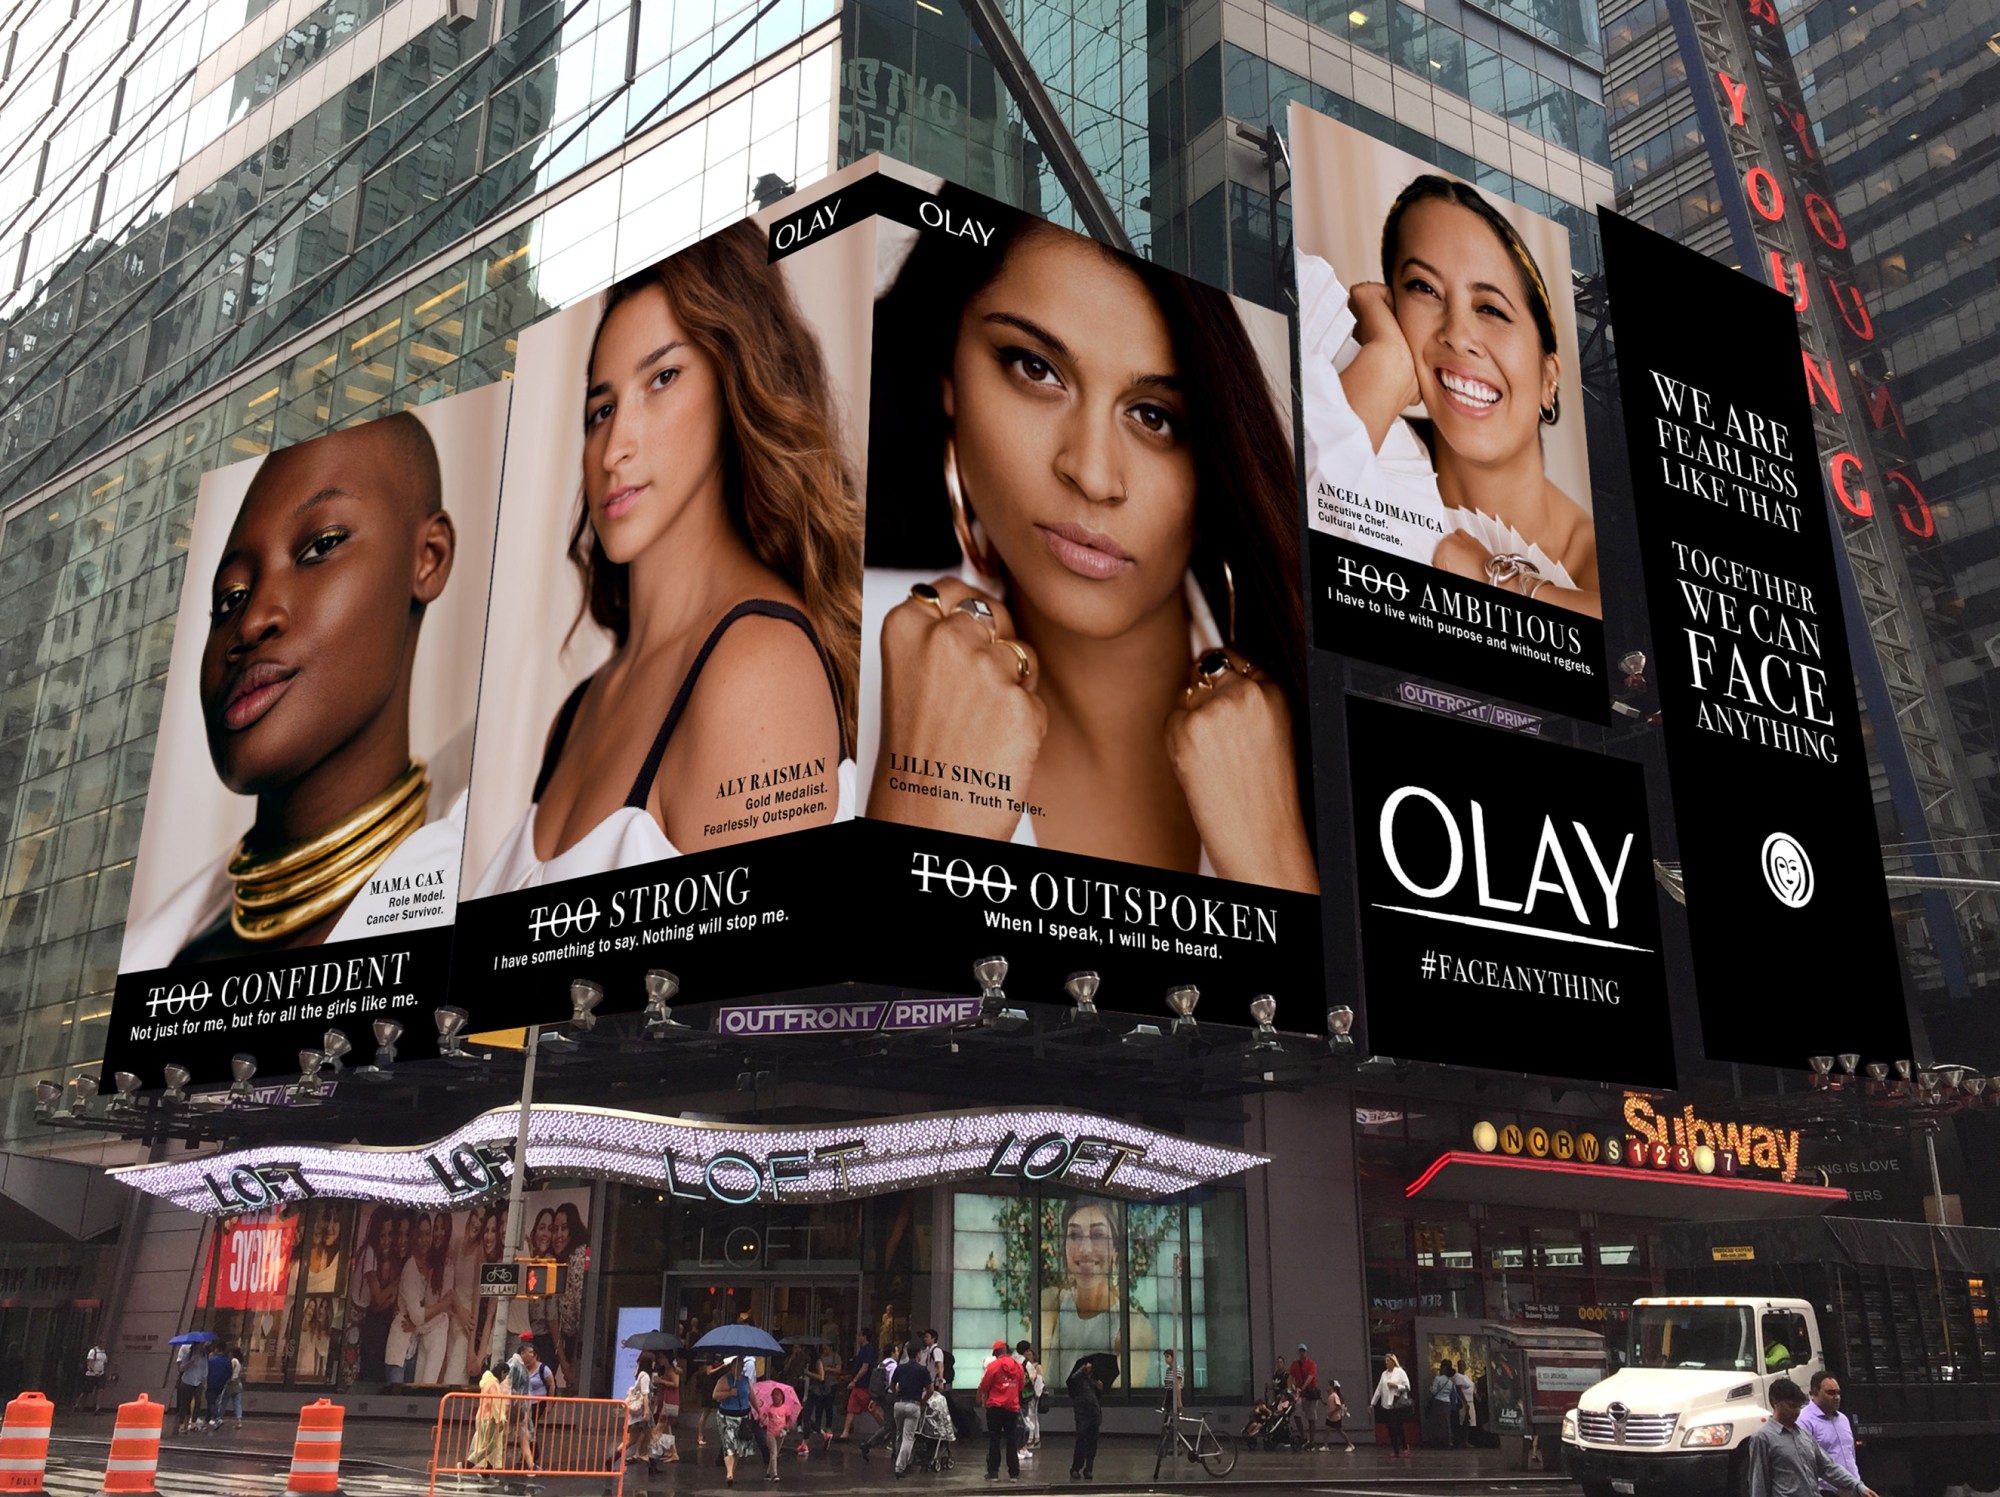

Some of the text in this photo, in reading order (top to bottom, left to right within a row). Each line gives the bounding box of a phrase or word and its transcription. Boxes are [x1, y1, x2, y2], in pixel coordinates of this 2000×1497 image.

[775, 199, 841, 249] OLAY
[919, 201, 995, 246] OLAY
[1719, 72, 1873, 517] YOUNG
[1649, 369, 1793, 462] WE ARE
[1656, 417, 1798, 498] FEARLESS
[1317, 482, 1444, 534] ANGELA DIMAYUGA
[1318, 498, 1388, 529] Executive Chef.
[1661, 456, 1801, 533] LIKE THAT
[1318, 511, 1402, 546] Cultural Advocate.
[1672, 541, 1817, 615] TOGETHER
[1338, 556, 1581, 654] TOO AMBITIOUS
[1677, 579, 1821, 659] WE CAN
[1328, 586, 1594, 676] I have to live with purpose and without regrets.
[1683, 628, 1834, 726] FACE
[1696, 700, 1838, 763] ANYTHING
[716, 758, 825, 799] ALY RAISMAN
[746, 782, 827, 809] Gold Medalist.
[889, 777, 1046, 817] Comedian. Truth Teller.
[890, 753, 1011, 792] LILLY SINGH
[704, 802, 827, 836] Fearlessly Outspoken.
[370, 870, 445, 895] MAMA CAX
[1380, 786, 1634, 929] OLAY
[367, 905, 444, 925] Cancer Survivor.
[389, 890, 445, 908] Role Model.
[529, 867, 751, 942] TOO STRONG
[911, 852, 1277, 944] TOO OUTSPOKEN
[493, 908, 789, 971] I have something to say. Nothing will stop me.
[984, 910, 1223, 959] When I speak, I will be heard.
[146, 952, 410, 1018] TOO CONFIDENT
[1421, 949, 1621, 1005] #FACEANYTHING
[130, 993, 418, 1041] Not just for me, but for all the girls like me.
[725, 1003, 974, 1032] OUTFRONT PRIME
[986, 1132, 1148, 1187] LOFT
[1623, 1096, 1799, 1182] Subway
[202, 1162, 318, 1210] LOFT
[663, 1139, 865, 1204] LOFT
[1847, 1162, 1858, 1173] IS
[1863, 1160, 1899, 1172] LOVE
[1848, 1190, 1883, 1201] TERS
[699, 1226, 825, 1268] LOFT
[481, 1284, 516, 1294] BIKE LANE
